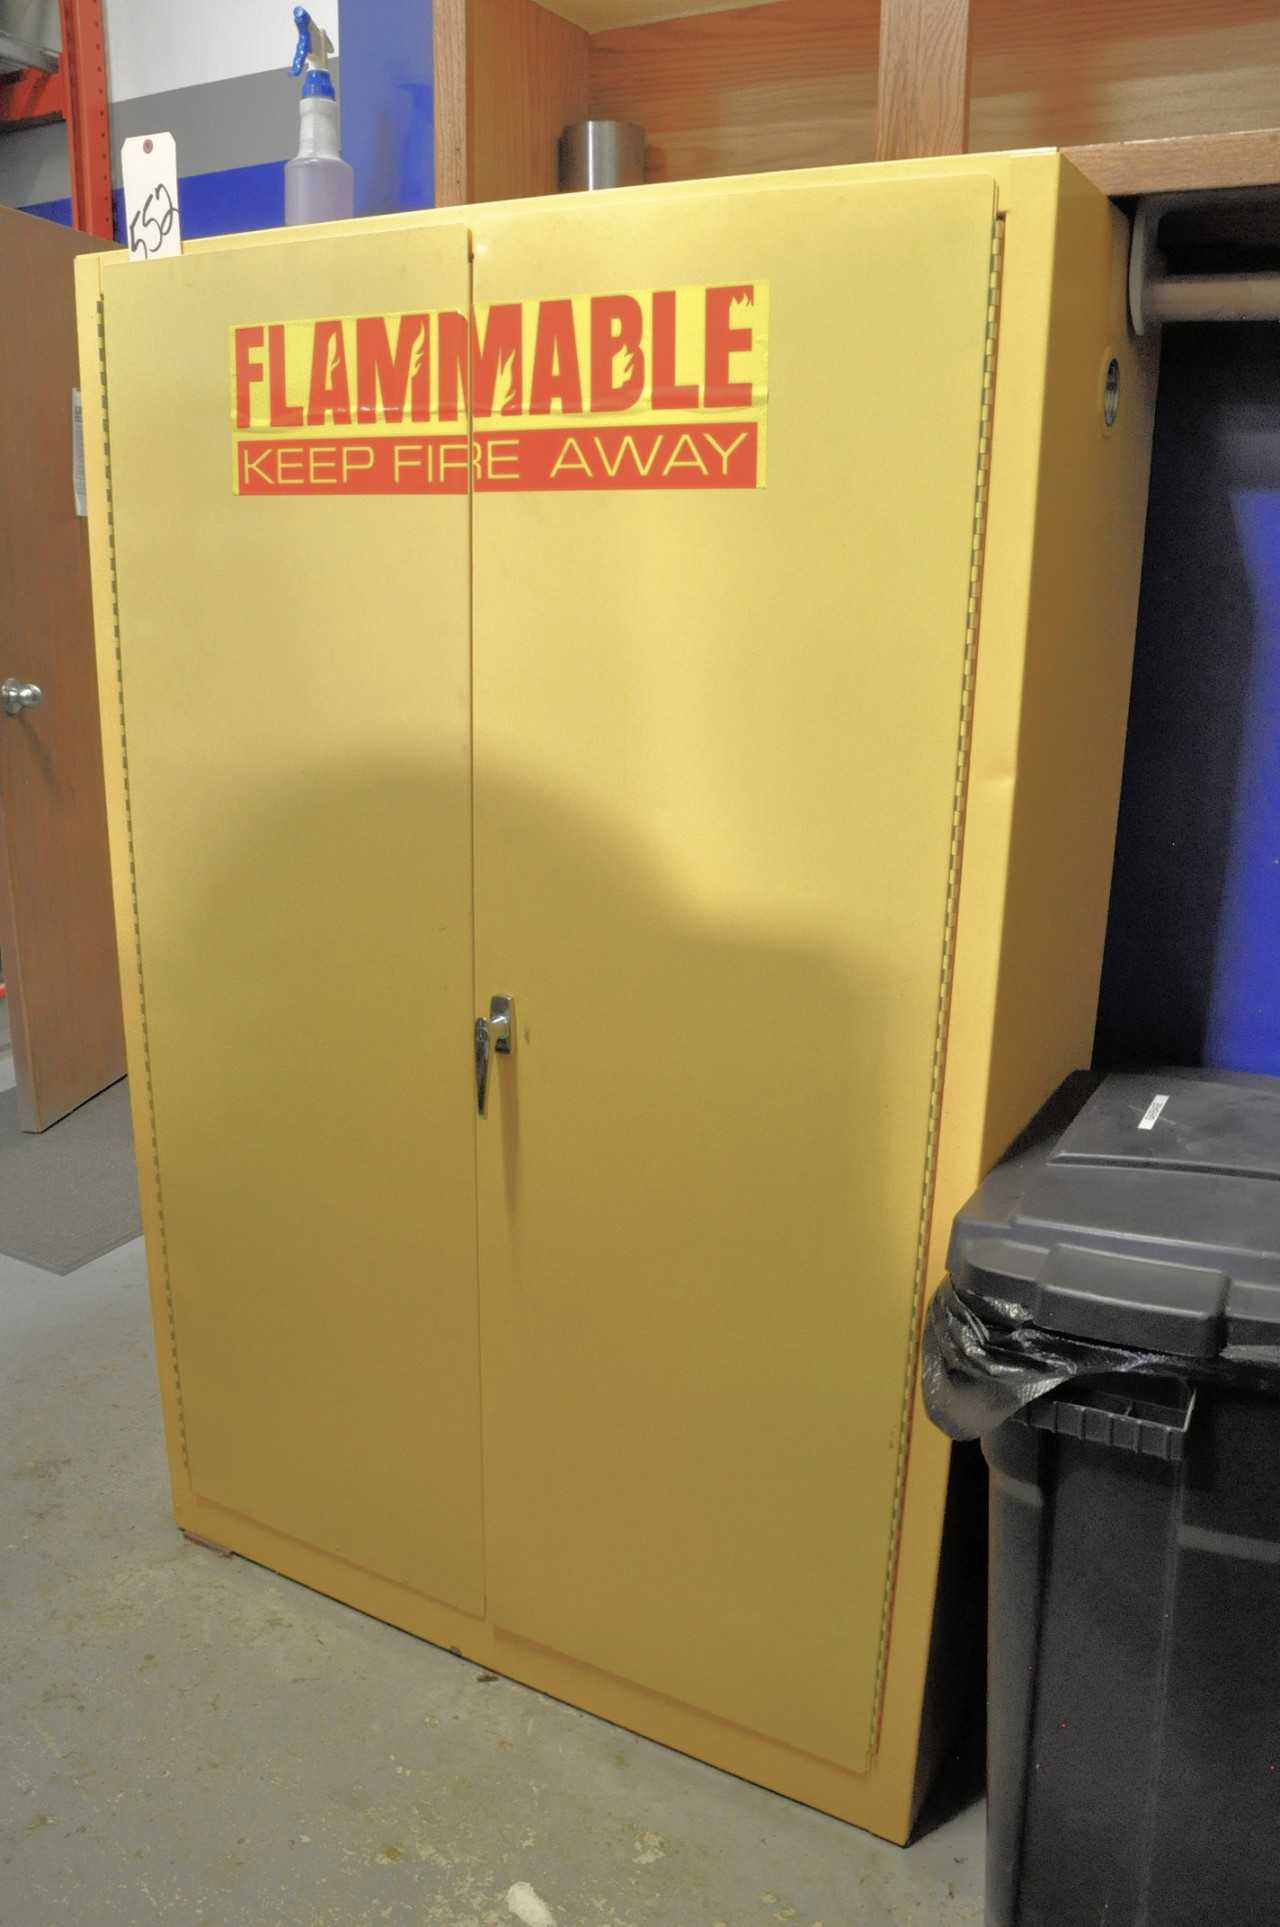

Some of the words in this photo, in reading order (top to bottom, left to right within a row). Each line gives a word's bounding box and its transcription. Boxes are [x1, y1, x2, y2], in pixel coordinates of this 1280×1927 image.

[130, 183, 181, 260] 552
[235, 284, 754, 429] FLAMMABLE
[243, 446, 375, 485] KEEP
[393, 439, 521, 484] FIRE
[549, 432, 748, 480] AWAY
